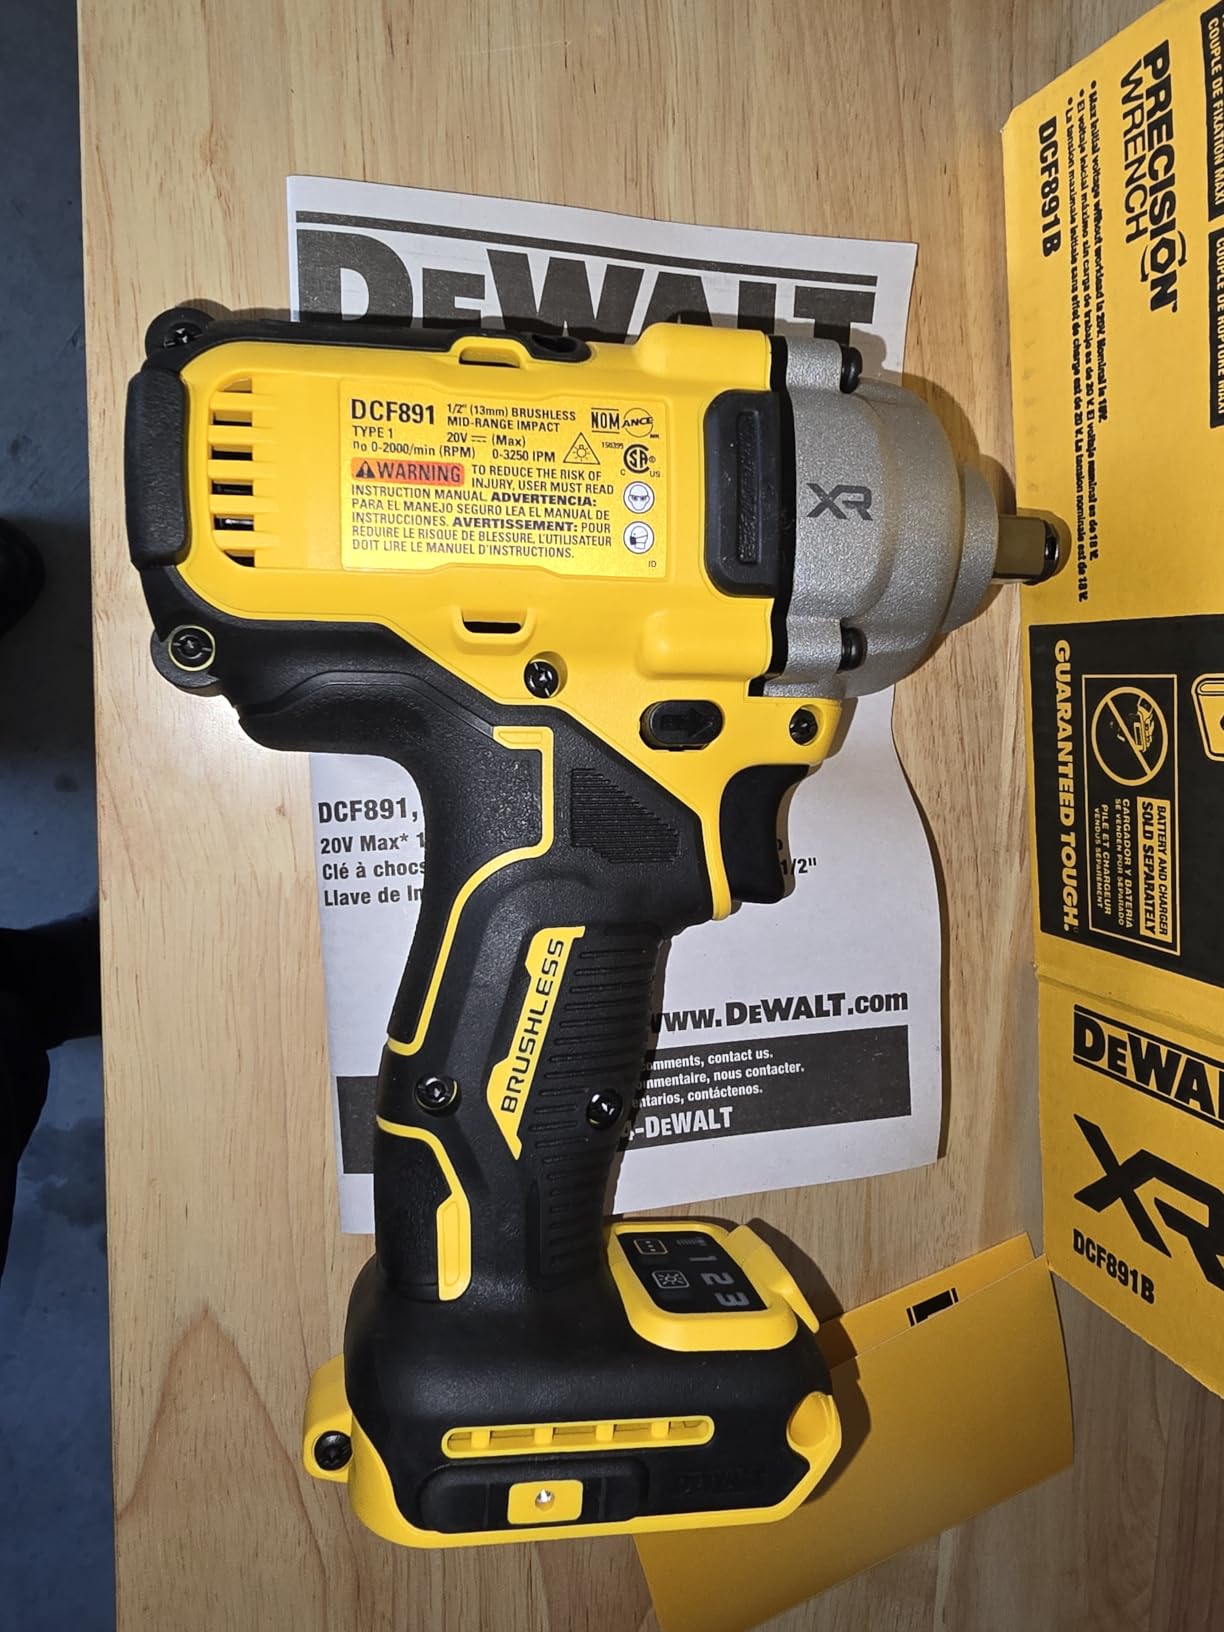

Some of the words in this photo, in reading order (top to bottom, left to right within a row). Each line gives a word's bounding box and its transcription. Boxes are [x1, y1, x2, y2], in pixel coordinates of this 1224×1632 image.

[1207, 17, 1223, 75] COUPLE
[1212, 78, 1224, 97] DE
[1120, 58, 1149, 244] WRENCH
[1039, 116, 1062, 257] DCF891B
[1143, 39, 1178, 312] PRECISION
[351, 398, 435, 425] DCF891
[470, 404, 508, 419] (13mm)
[511, 407, 577, 421] BRUSHLESS
[591, 411, 620, 430] NOM
[621, 416, 654, 428] ANCE
[352, 425, 384, 439] TYPE
[388, 428, 393, 438] 1
[447, 416, 513, 430] MID-RANGE
[517, 420, 561, 432] IMPACT
[371, 441, 436, 456] 0-2000/min
[439, 445, 476, 459] (RPM)
[447, 431, 468, 443] 20V
[491, 433, 526, 448] (Max)
[492, 448, 529, 461] 0-3250
[532, 451, 556, 463] IPM
[376, 460, 462, 483] WARNING
[472, 464, 486, 475] TO
[489, 465, 534, 478] REDUCE
[536, 467, 557, 479] THE
[560, 469, 585, 480] RISK
[588, 470, 602, 481] OF
[351, 484, 431, 499] INSTRUCTION
[434, 489, 487, 501] MANUAL
[491, 491, 597, 507] ADVERTENCIA:
[472, 477, 516, 491] INJURY,
[518, 479, 547, 492] USER
[550, 482, 584, 494] MUST
[585, 484, 614, 495] READ
[352, 498, 384, 510] PARA
[387, 500, 400, 511] EL
[403, 501, 453, 514] MANEJO
[456, 504, 502, 516] SEGURO
[505, 505, 526, 517] LEA
[529, 506, 541, 518] EL
[544, 507, 593, 520] MANUAL
[595, 510, 610, 521] DE
[806, 482, 873, 521] XR
[352, 511, 449, 527] INSTRUCCIONES.
[452, 517, 578, 533] AVERTISSEMENT:
[581, 522, 611, 534] POUR
[403, 527, 415, 539] LE
[418, 528, 457, 541] RISQUE
[461, 530, 476, 541] DE
[538, 533, 612, 547] L'UTILISATEUR
[352, 539, 380, 551] DOIT
[383, 540, 408, 552] LIRE
[411, 541, 423, 552] LE
[426, 542, 476, 555] MANUEL
[478, 545, 575, 559] D'INSTRUCTIONS.
[1055, 640, 1075, 827] GUARANTEED
[318, 797, 418, 824] DCF891,
[1101, 804, 1109, 830] PILE
[1142, 801, 1154, 841] SOLD
[1102, 833, 1110, 848] ET
[1122, 798, 1131, 865] CARGADOR
[1157, 806, 1167, 855] BATTERY
[320, 836, 353, 854] 20V
[322, 862, 349, 880] Clé
[356, 861, 366, 878] à
[1158, 857, 1168, 881] AND
[1060, 831, 1078, 931] TOUGH.
[1102, 851, 1111, 915] CHARGEUR
[1143, 843, 1156, 935] SEPARATELY
[324, 889, 371, 906] Llave
[378, 886, 400, 903] de
[1158, 884, 1168, 936] CHARGER
[501, 938, 564, 1113] BRUSHLESS
[707, 1048, 752, 1066] contact
[755, 1049, 773, 1060] us.
[713, 1070, 742, 1082] nous
[745, 1062, 805, 1078] contacter.
[687, 1085, 763, 1101] contáctenos.
[1074, 1113, 1224, 1292] XR
[1073, 1228, 1155, 1304] DCF891B
[701, 1272, 735, 1285] 2
[714, 1292, 750, 1307] 3
